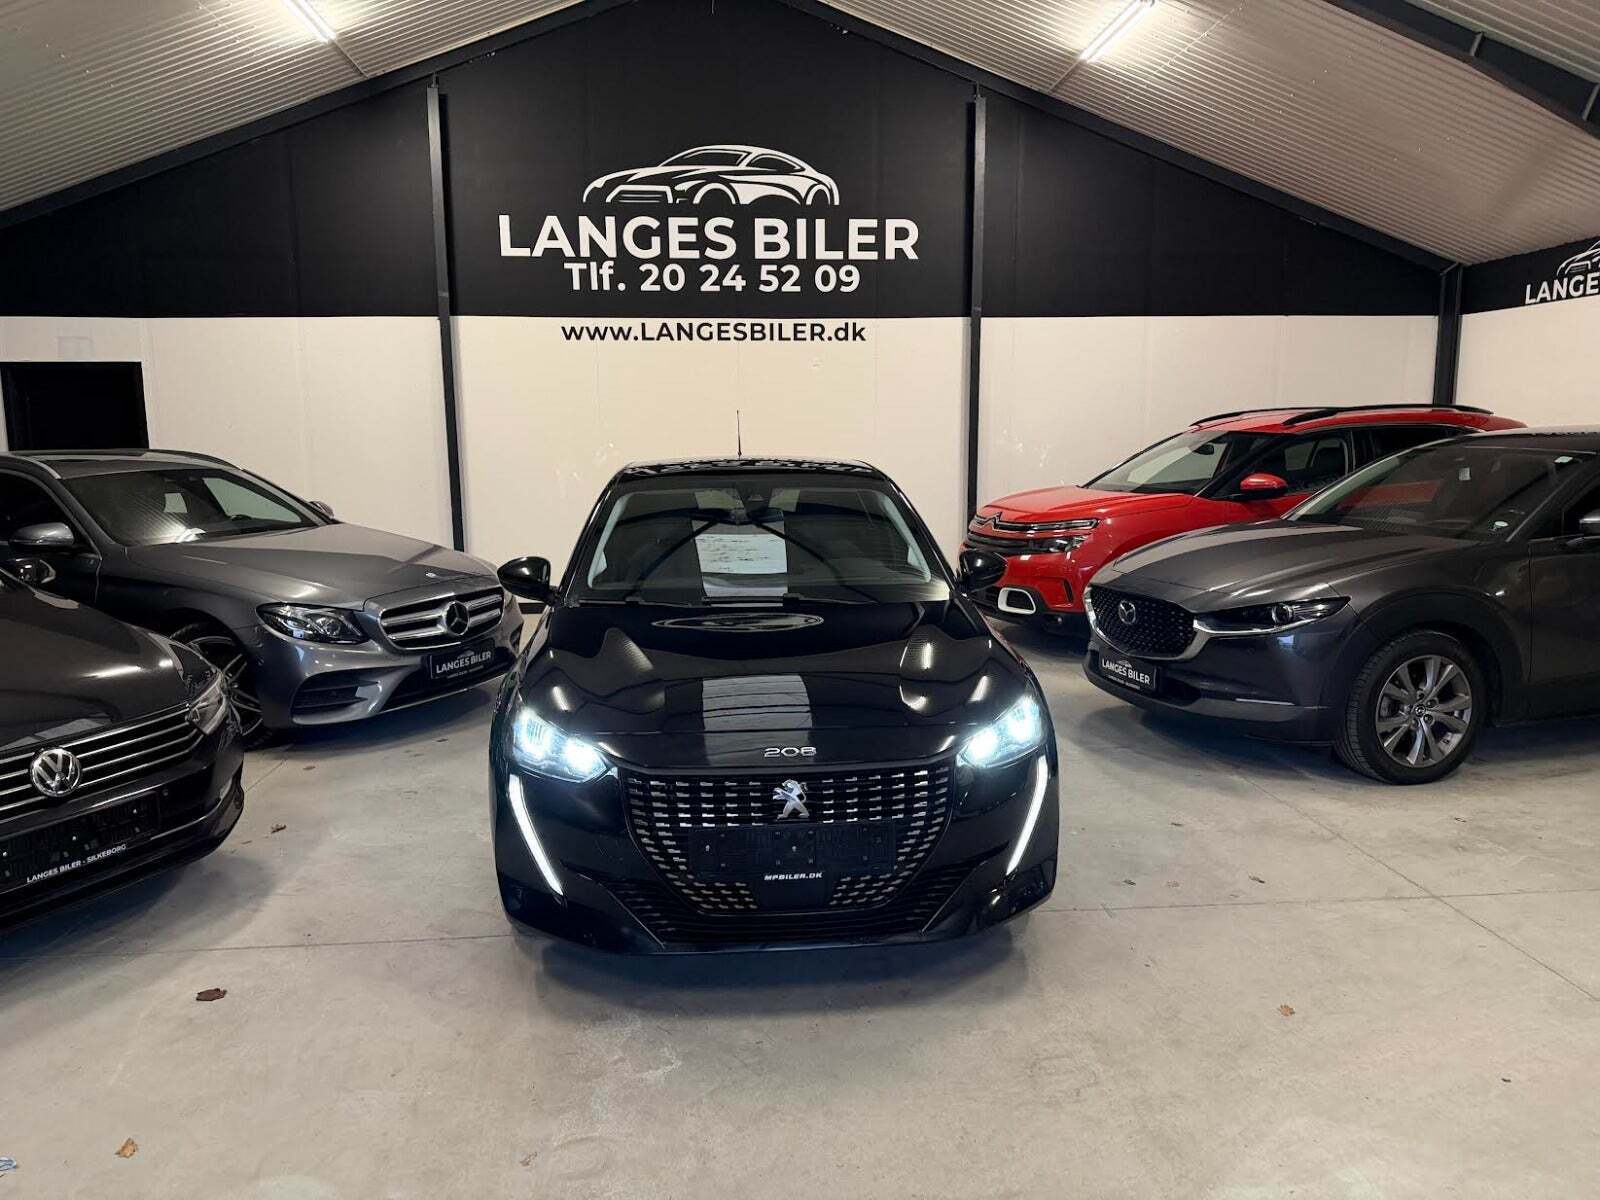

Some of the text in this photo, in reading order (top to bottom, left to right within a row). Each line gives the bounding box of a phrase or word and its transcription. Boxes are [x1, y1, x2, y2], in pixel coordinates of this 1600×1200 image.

[498, 214, 919, 261] LANGES BILER
[563, 260, 861, 293] Tlf. 20 24 52 09
[561, 322, 867, 342] www.LANGESBILER.dk
[436, 656, 470, 674] LANGES
[470, 650, 492, 665] BILER
[1101, 658, 1127, 677] LANGES
[1127, 668, 1150, 685] BILER
[764, 746, 817, 758] 208
[26, 866, 59, 883] LANGES
[59, 860, 82, 874] BILER
[86, 843, 127, 864] SILKEBORG
[764, 871, 823, 881] MPBILER.DK
